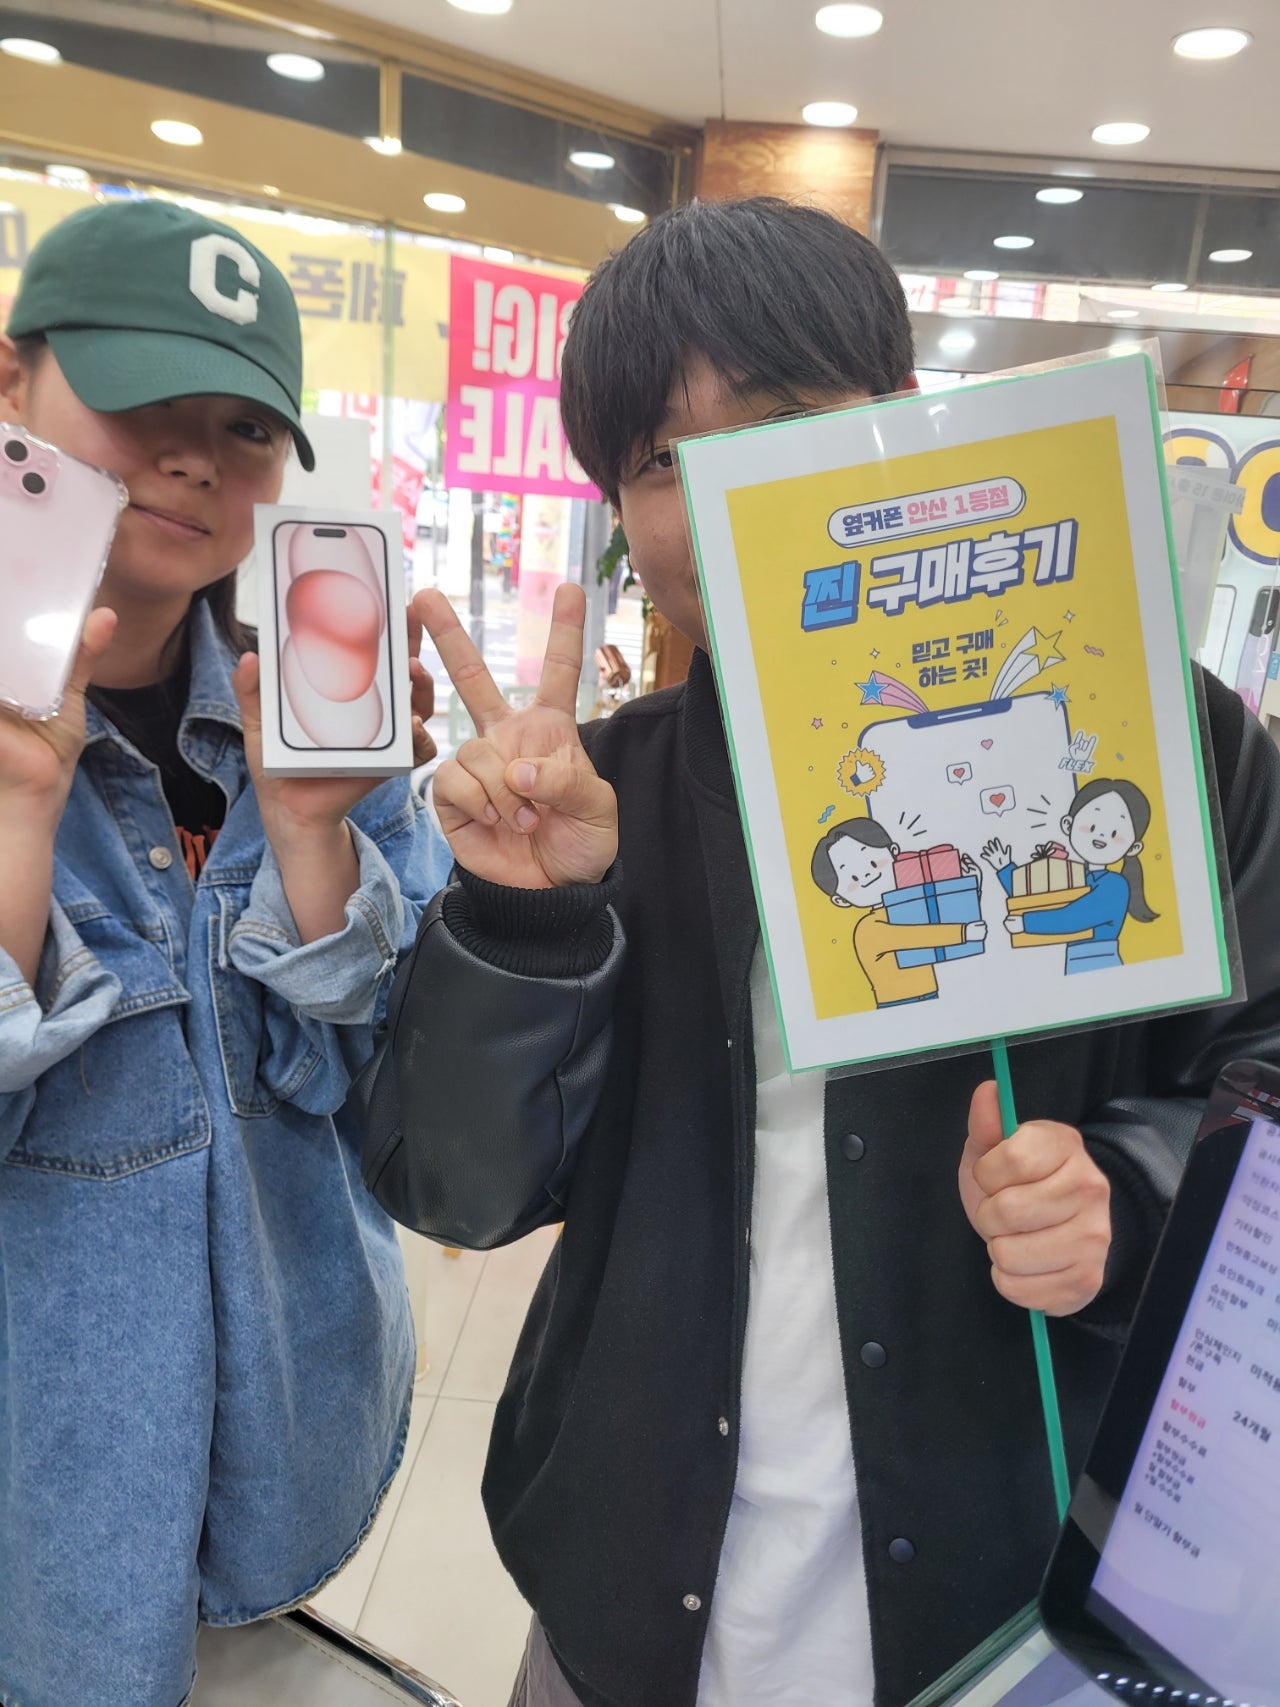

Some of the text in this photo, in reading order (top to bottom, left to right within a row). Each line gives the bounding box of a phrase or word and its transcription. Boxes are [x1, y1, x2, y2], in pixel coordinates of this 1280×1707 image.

[189, 233, 260, 326] C
[842, 485, 1010, 537] 옆커폰 안산 1등점
[801, 518, 1078, 632] 찐 구매후기
[912, 629, 994, 664] 믿고 구매
[918, 657, 988, 688] 하는 곳!
[1058, 757, 1095, 773] FLEX
[1234, 1217, 1273, 1245] 기타할인
[1217, 1263, 1265, 1296] 포인트파크
[1206, 1294, 1225, 1313] 카드
[1210, 1283, 1249, 1310] 슈퍼할부
[1186, 1354, 1204, 1373] 현금
[1169, 1398, 1207, 1430] 할부원금
[1177, 1376, 1271, 1442] 할부 24개월
[1155, 1439, 1187, 1467] 할부원금
[1162, 1420, 1208, 1458] 할부수수료
[1157, 1468, 1181, 1491] 할부금
[1158, 1482, 1182, 1504] 수수료
[1133, 1501, 1201, 1559] 월 단말기 할부금
